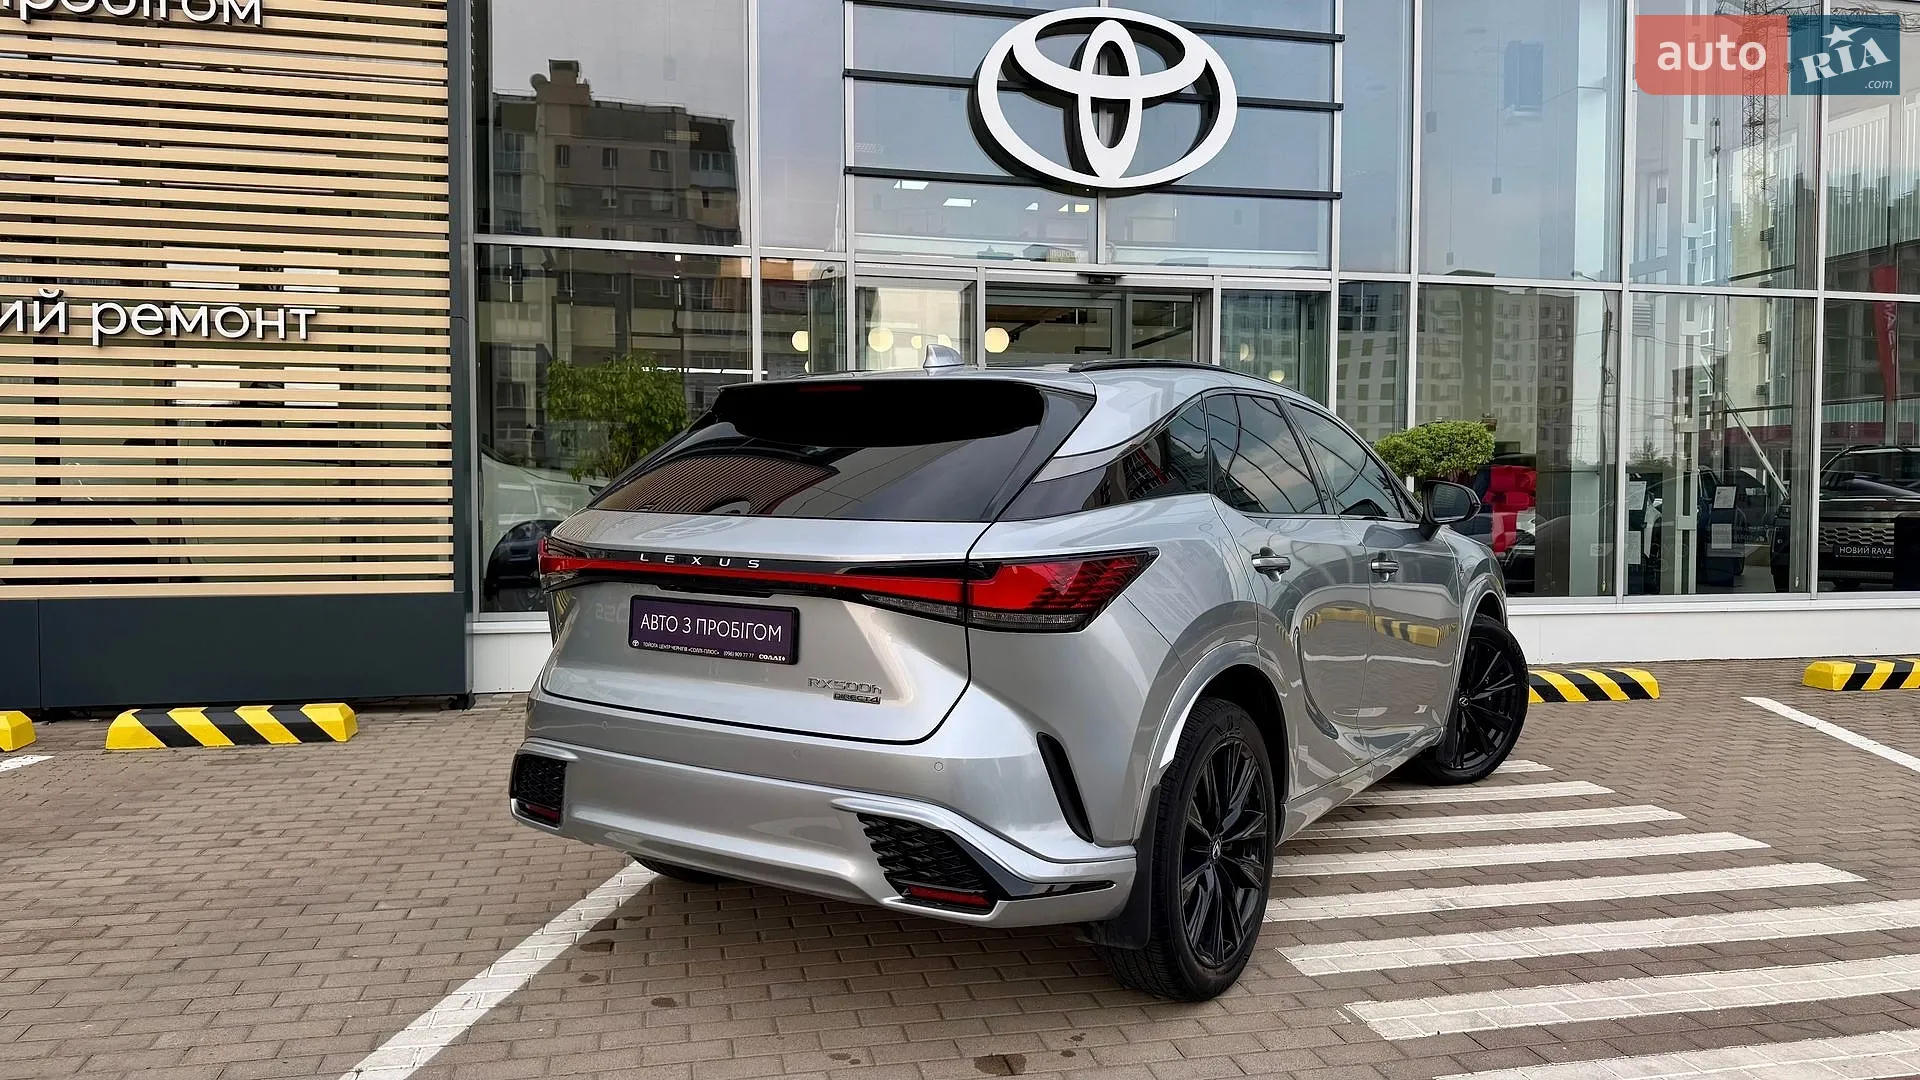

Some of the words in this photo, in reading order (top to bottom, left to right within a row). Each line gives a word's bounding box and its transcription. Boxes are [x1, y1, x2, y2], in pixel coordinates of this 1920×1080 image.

[91, 301, 317, 347] ремонт
[1839, 546, 1870, 555] НОВИЙ
[1871, 547, 1892, 555] RAV4
[639, 552, 760, 569] LEXUS
[640, 613, 678, 633] АВТО
[682, 617, 692, 634] З
[696, 618, 782, 643] ПРОБІГОМ
[807, 676, 882, 695] RX500h
